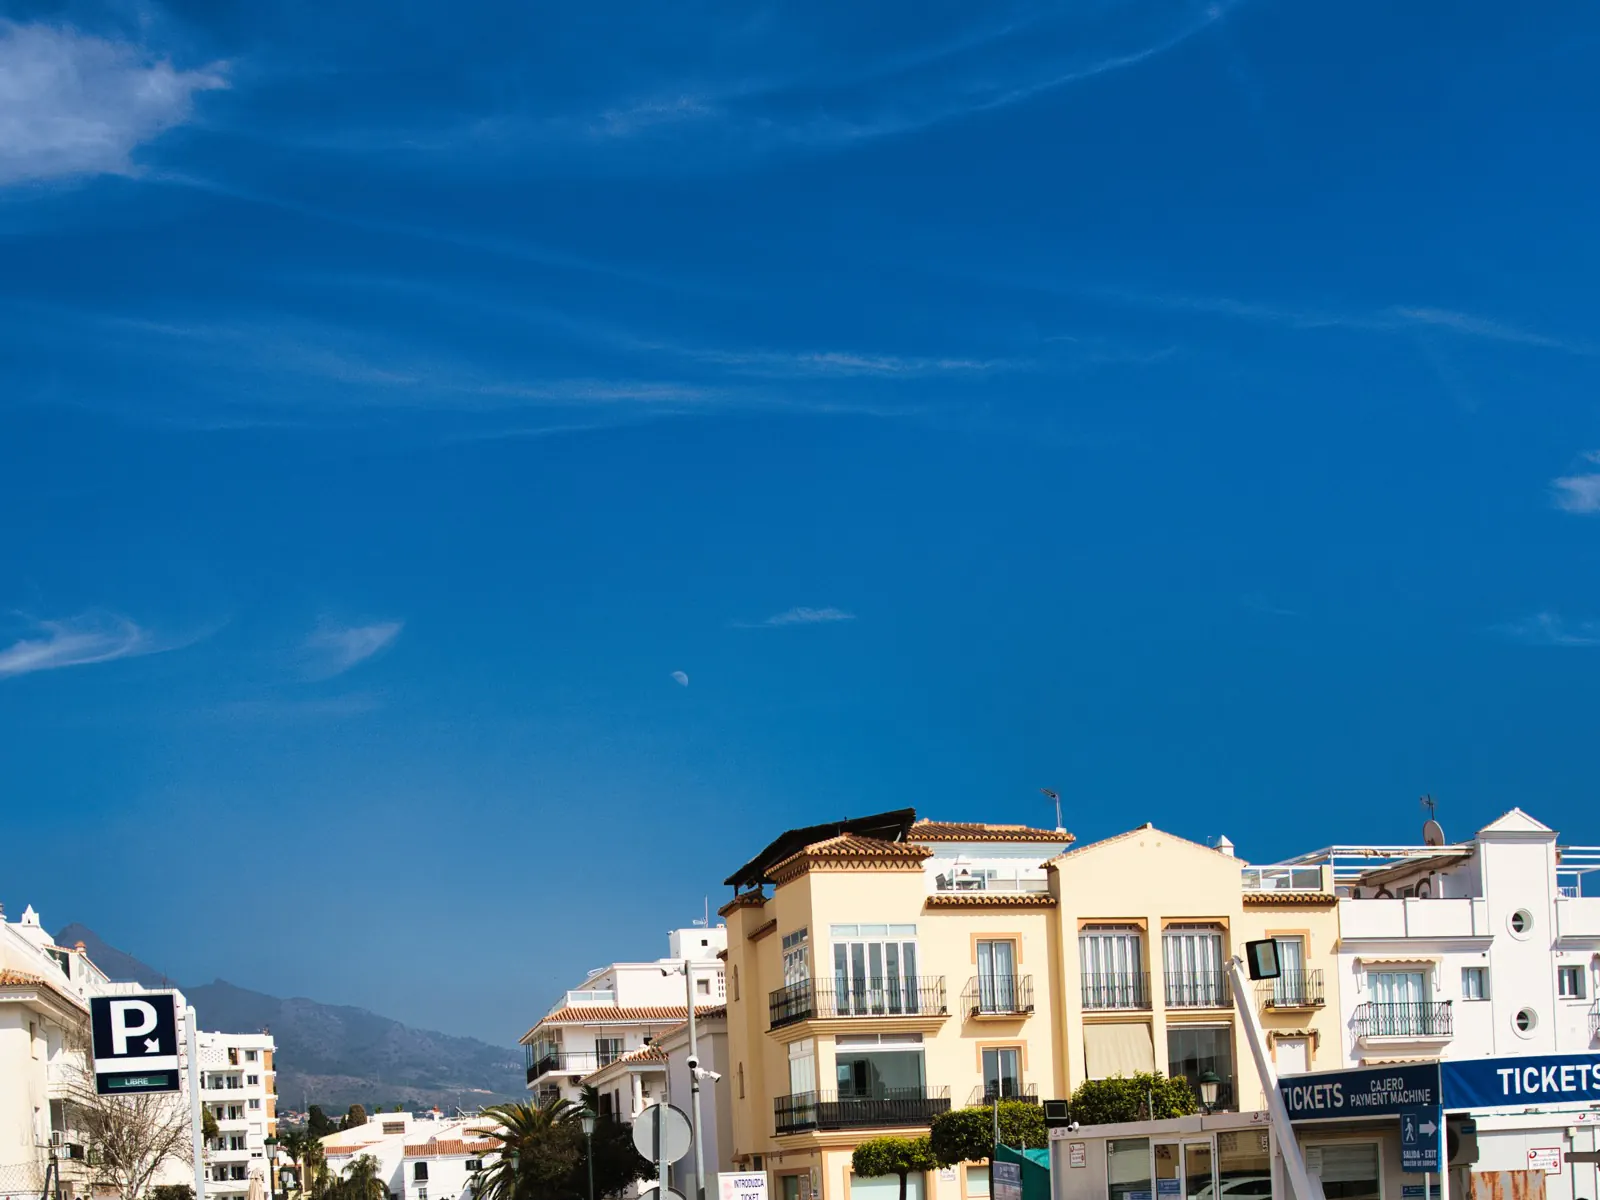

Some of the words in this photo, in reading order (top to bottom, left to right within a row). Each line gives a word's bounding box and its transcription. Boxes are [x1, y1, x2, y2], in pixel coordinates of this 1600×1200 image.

[109, 1000, 158, 1055] P
[125, 1077, 149, 1086] LIBRE
[1370, 1077, 1404, 1092] CAJERO
[1350, 1092, 1389, 1107] PAYMENT
[1390, 1088, 1431, 1104] MACHINE
[1403, 1150, 1420, 1159] SALIDA
[1424, 1149, 1437, 1159] EXIT
[734, 1178, 764, 1188] INTRODUZCA
